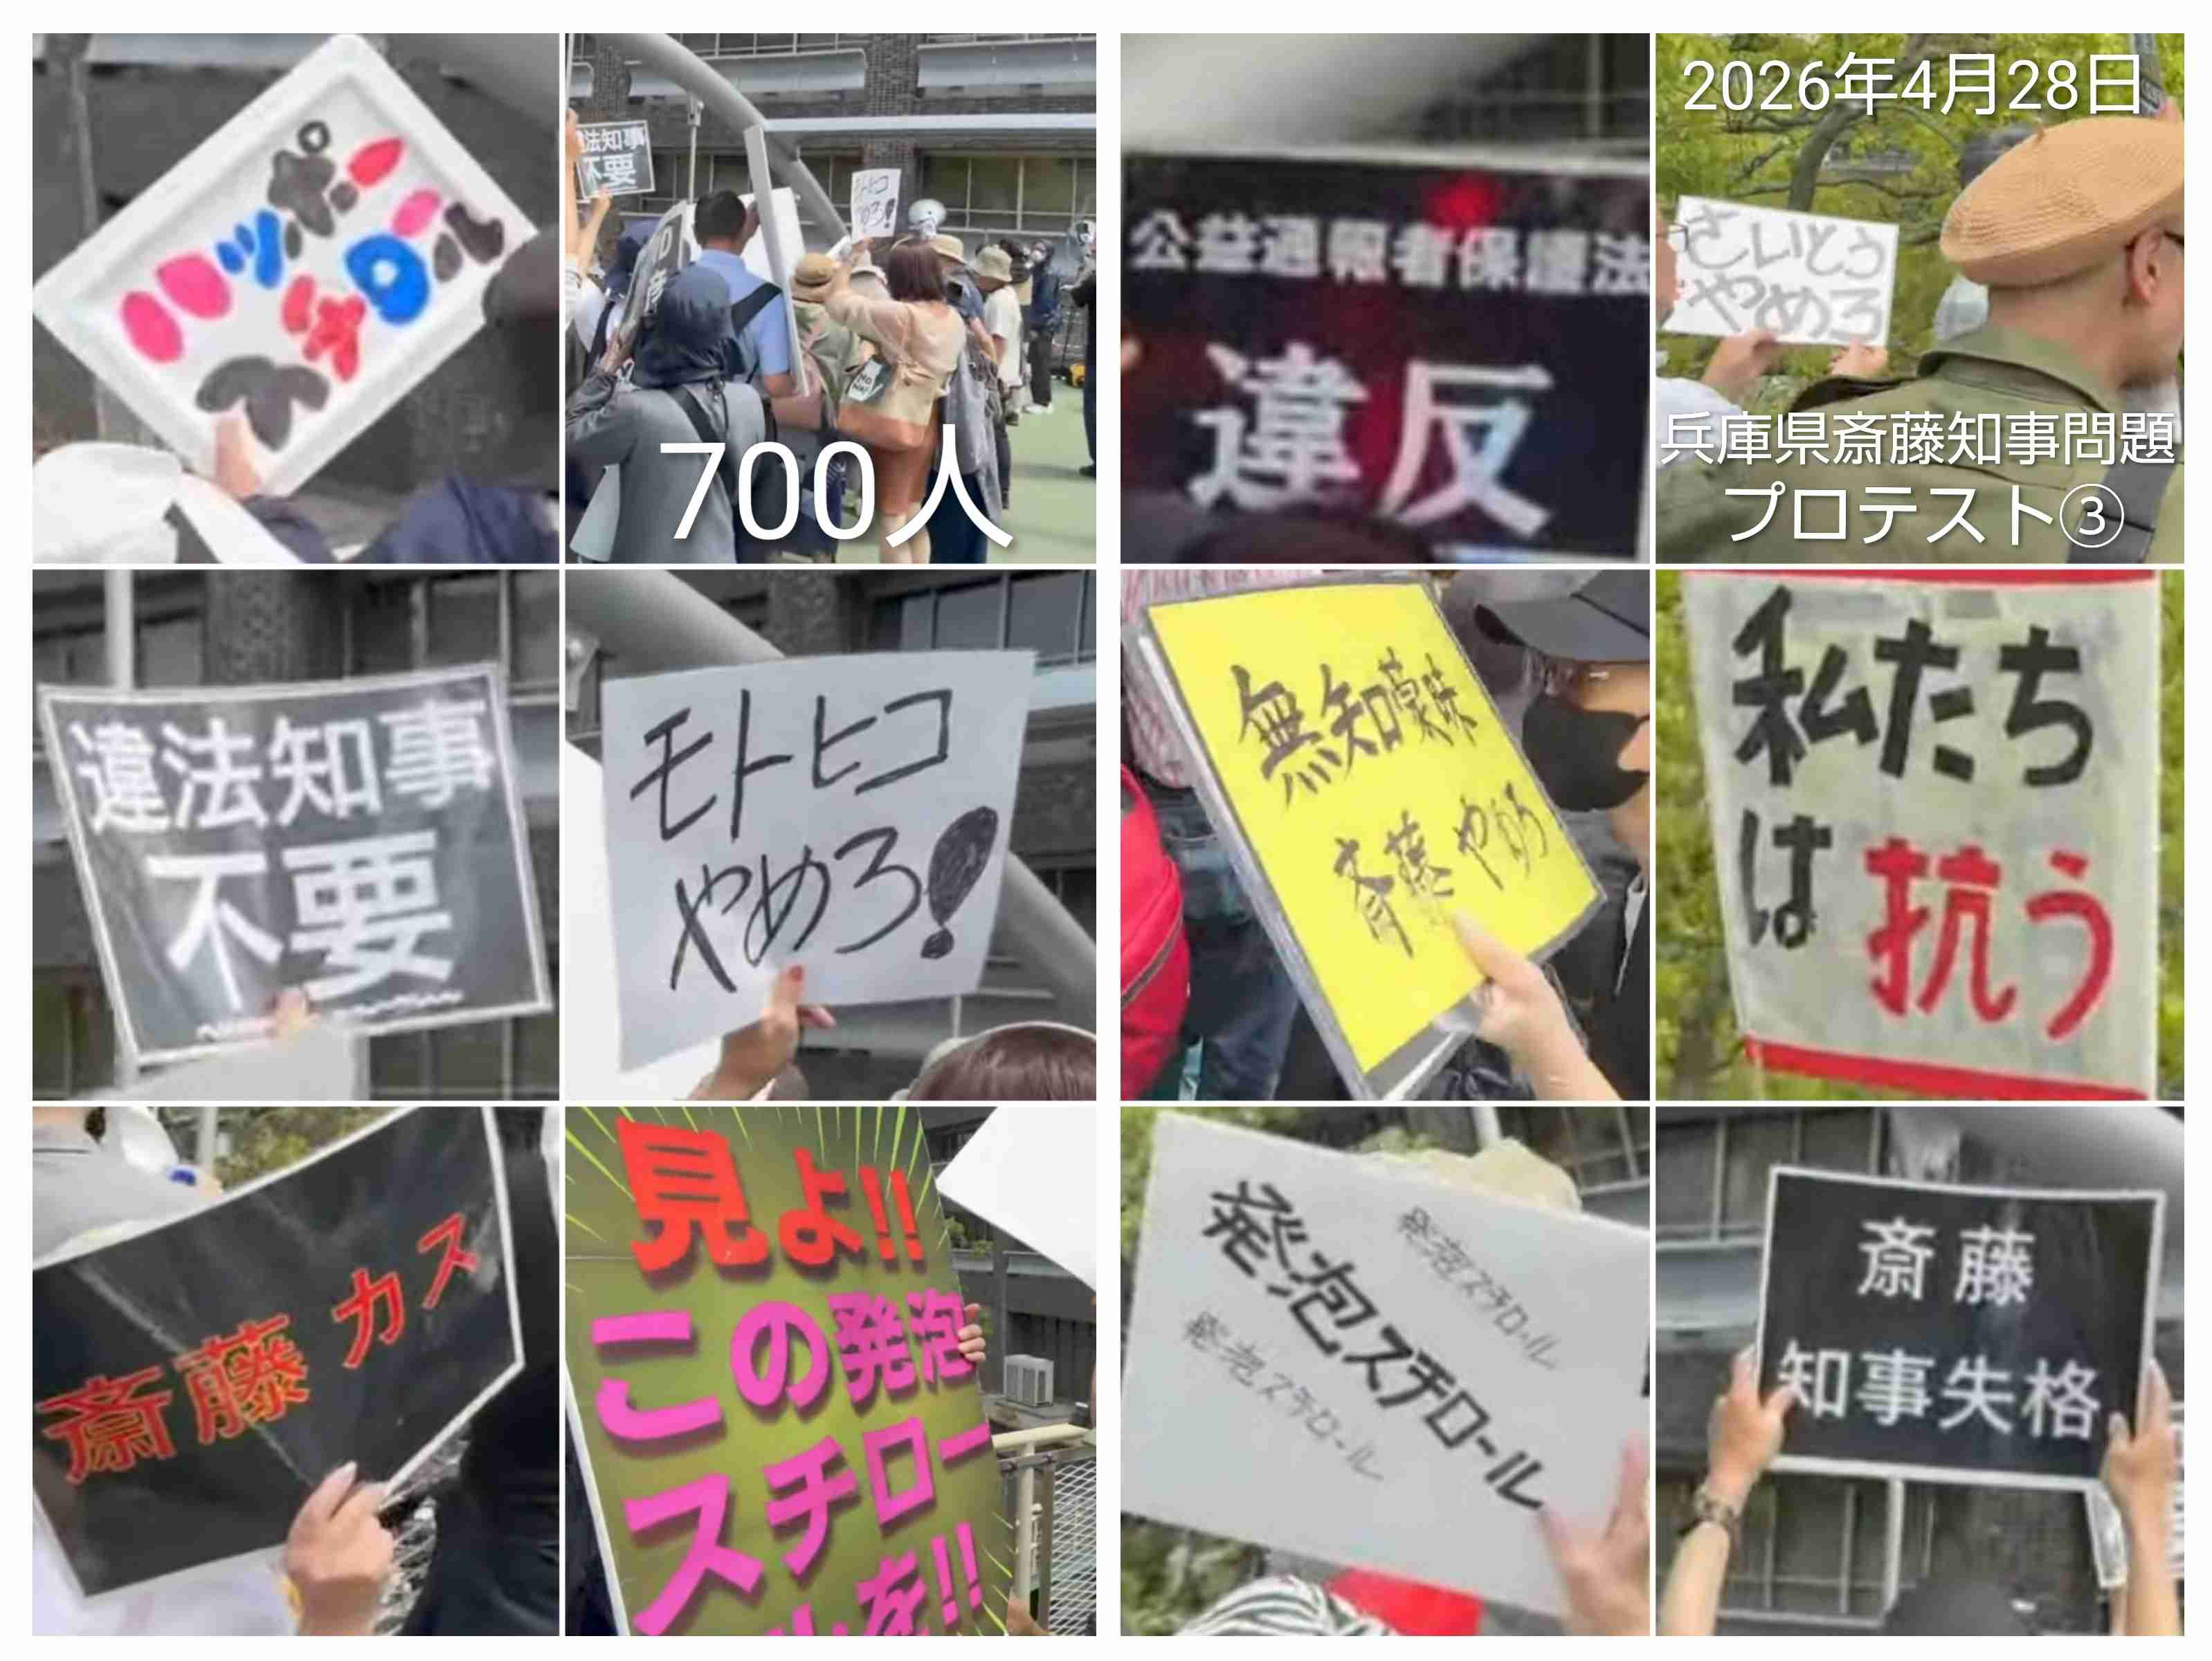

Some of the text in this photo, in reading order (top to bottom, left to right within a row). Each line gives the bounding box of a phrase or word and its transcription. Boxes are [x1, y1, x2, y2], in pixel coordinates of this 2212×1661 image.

[1131, 209, 1650, 296] 公益通報者保護法
[1685, 206, 1886, 278] さいとう
[1686, 274, 1884, 342] やめろ
[1188, 342, 1554, 537] 違反
[1732, 585, 2094, 787] 私たち
[69, 698, 496, 833] 違法知事
[630, 688, 952, 843] モトヒコ
[146, 831, 452, 1010] 不要
[1858, 1216, 2036, 1306] 斎藤
[592, 1287, 974, 1440] この発泡
[1202, 1180, 1544, 1511] 発泡スチロール
[1777, 1340, 2102, 1440] 知事失格
[623, 1416, 992, 1635] スチロー
[763, 1520, 982, 1635] を!!
